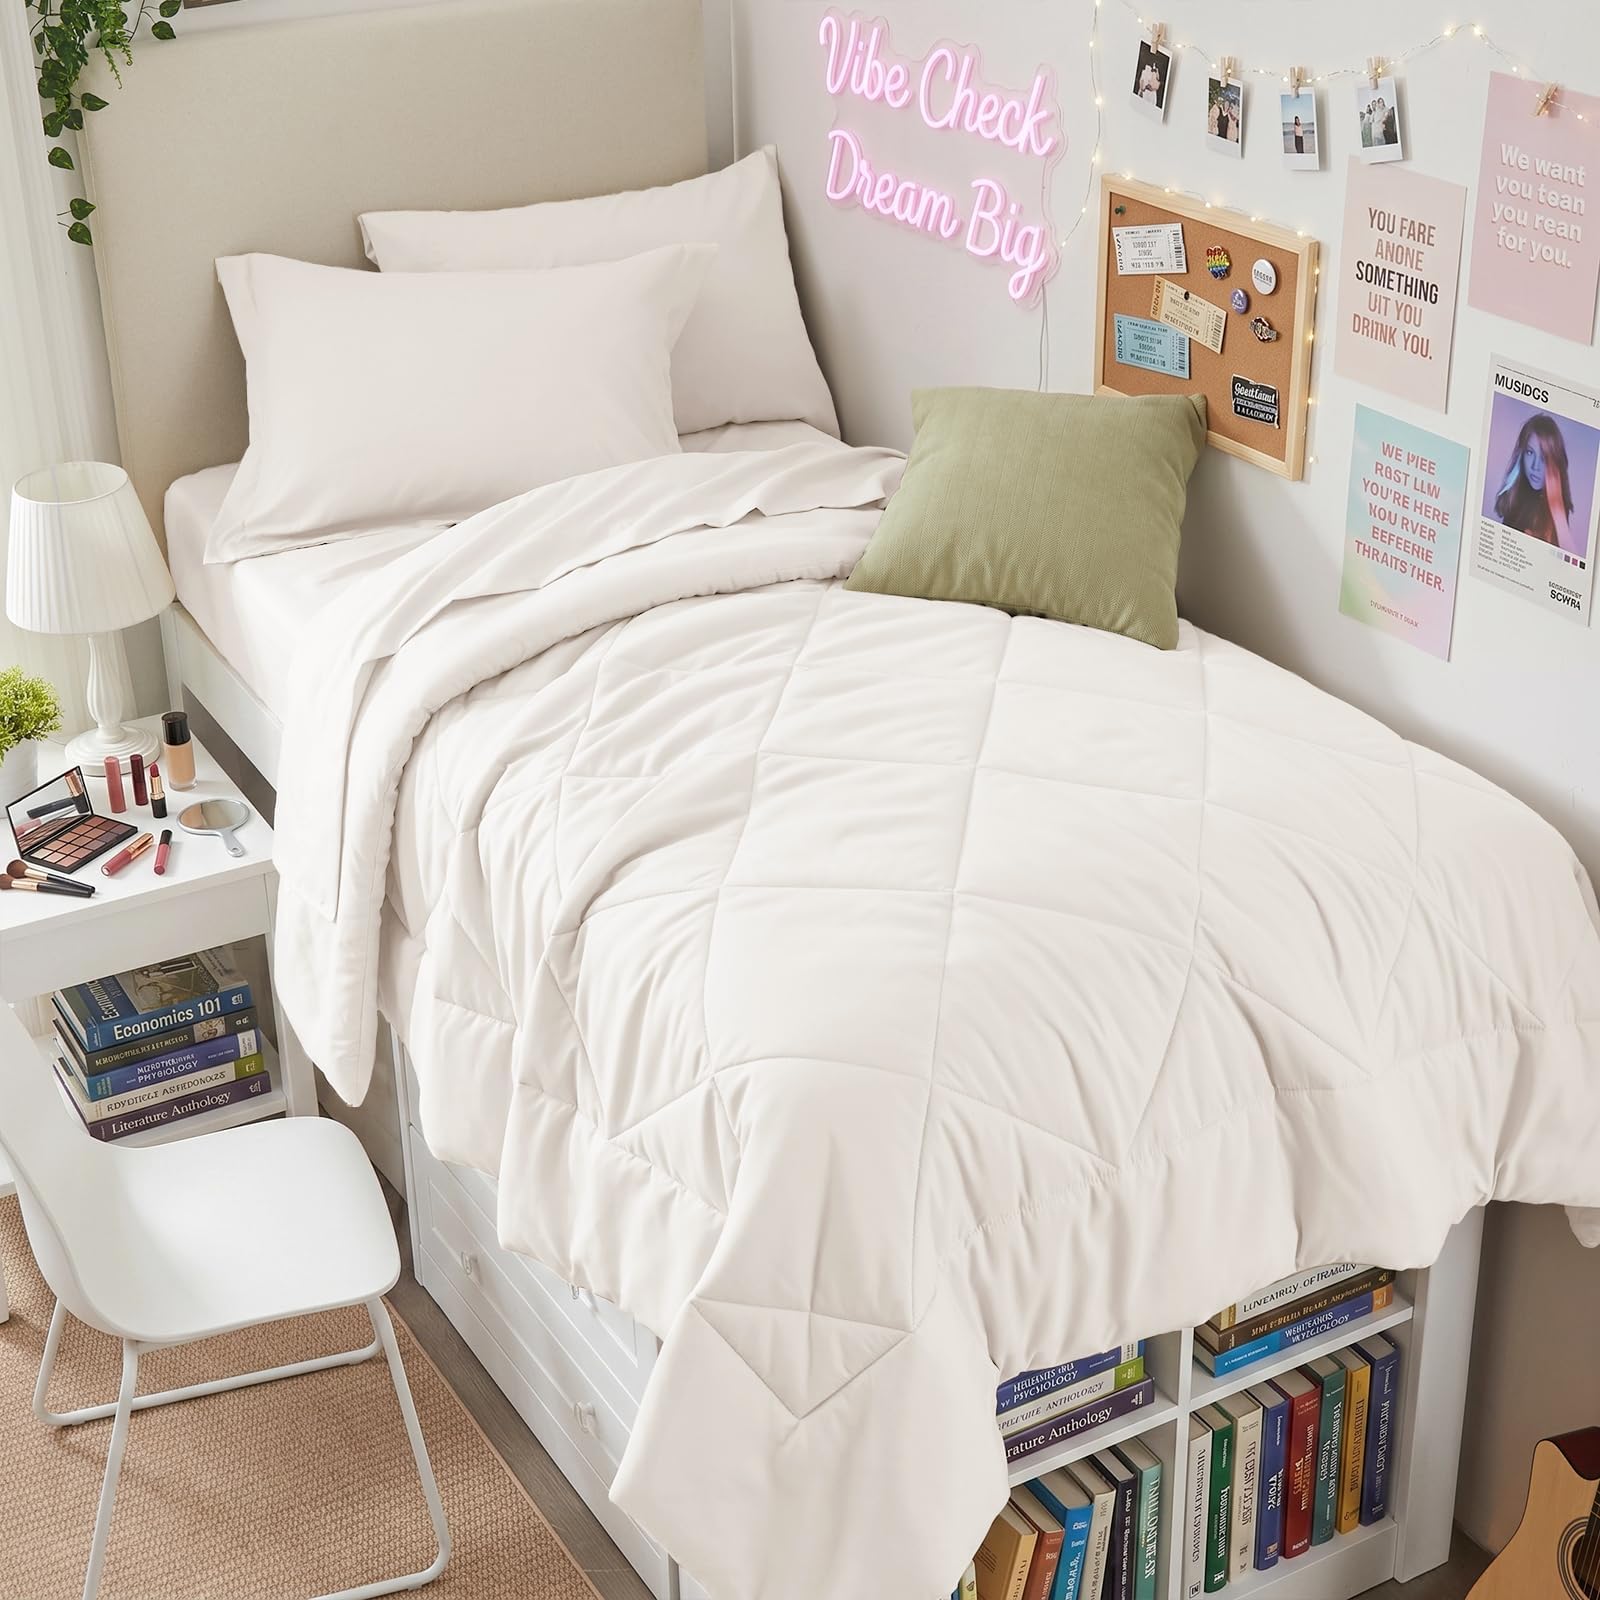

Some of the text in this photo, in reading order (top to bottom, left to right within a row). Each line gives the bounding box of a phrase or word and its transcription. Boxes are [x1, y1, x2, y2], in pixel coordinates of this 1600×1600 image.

[819, 16, 1053, 156] Vibe Check
[1500, 143, 1585, 187] We want
[826, 129, 1046, 300] Dream Big
[1368, 207, 1437, 247] YOU FARE
[1491, 201, 1582, 243] you rean
[1375, 238, 1425, 272] ANONE
[1496, 226, 1573, 268] for you.
[1355, 260, 1439, 305] SOMETHING
[1368, 291, 1423, 328] UIT YOU
[1402, 330, 1433, 360] YOU.
[1381, 441, 1403, 462] WE
[1362, 477, 1450, 527] YOU'RE HERE
[1400, 516, 1437, 544] RVER
[113, 997, 222, 1041] Economics 101
[111, 1091, 231, 1135] Literature Anthology
[1048, 1407, 1113, 1440] Anthology
